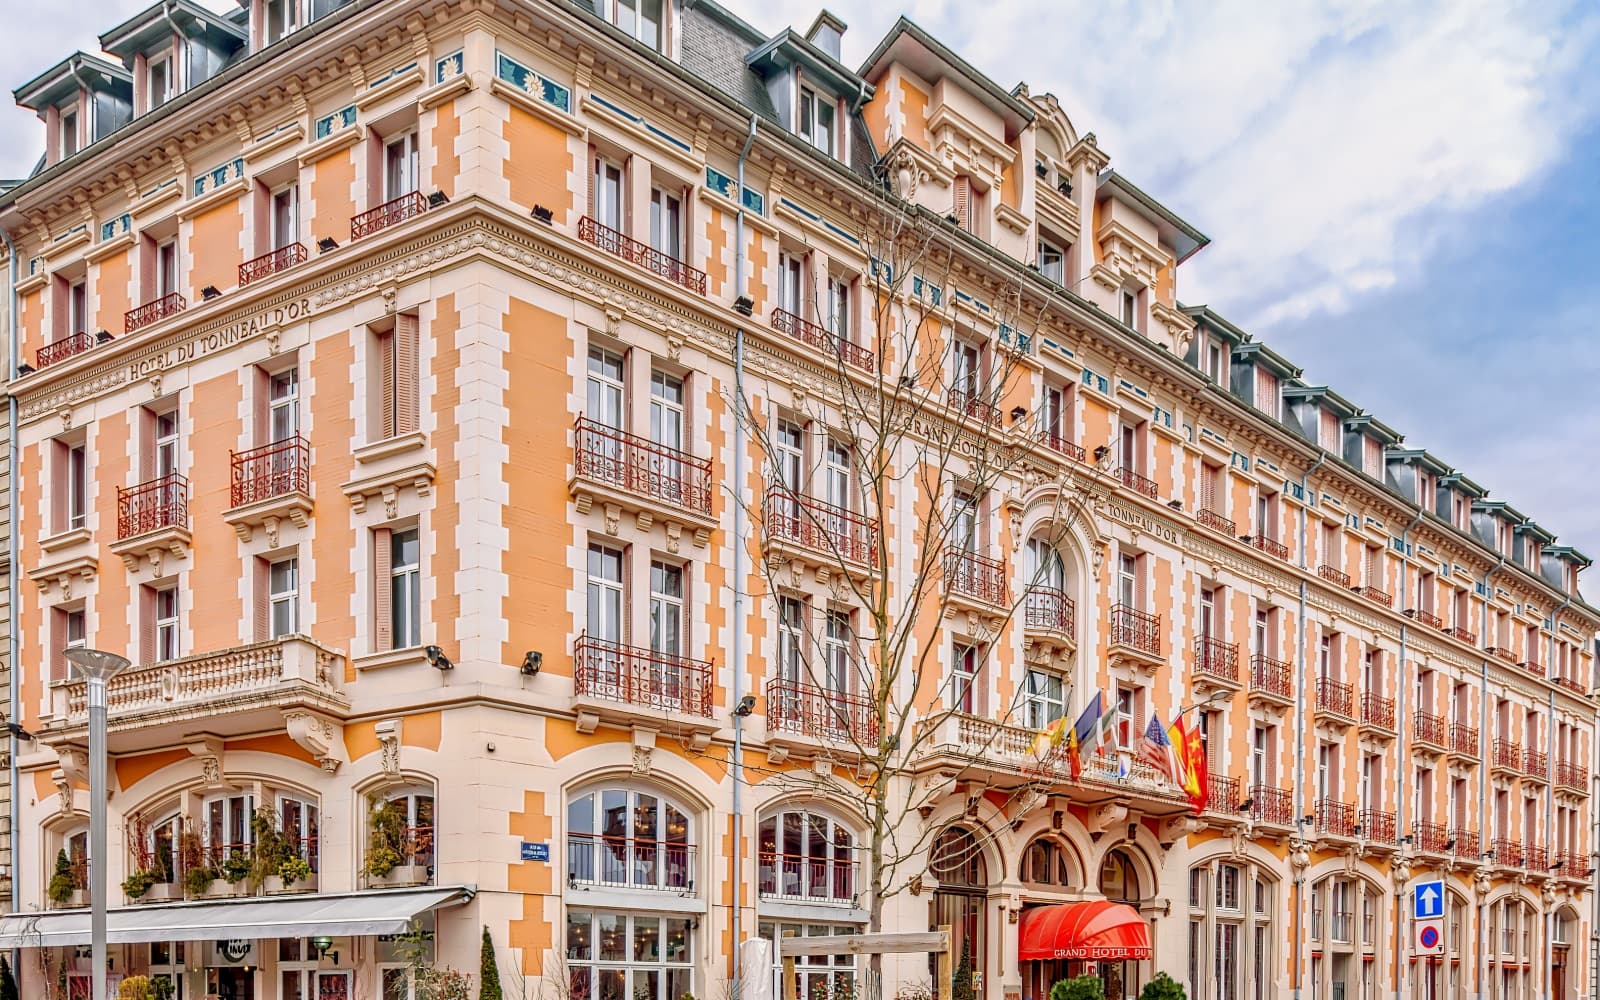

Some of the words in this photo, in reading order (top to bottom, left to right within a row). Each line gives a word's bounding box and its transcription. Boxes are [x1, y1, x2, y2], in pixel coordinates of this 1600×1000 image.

[130, 352, 173, 381] HOTEL
[177, 343, 195, 363] DU
[200, 318, 268, 354] TONNEAU
[274, 299, 311, 323] D'OR
[903, 416, 949, 446] GRAND
[1108, 503, 1153, 533] TONNEAU
[1156, 524, 1177, 544] D'OR
[1054, 948, 1087, 957] GRAND
[1092, 948, 1130, 957] HOTEL
[1134, 948, 1146, 957] DU
